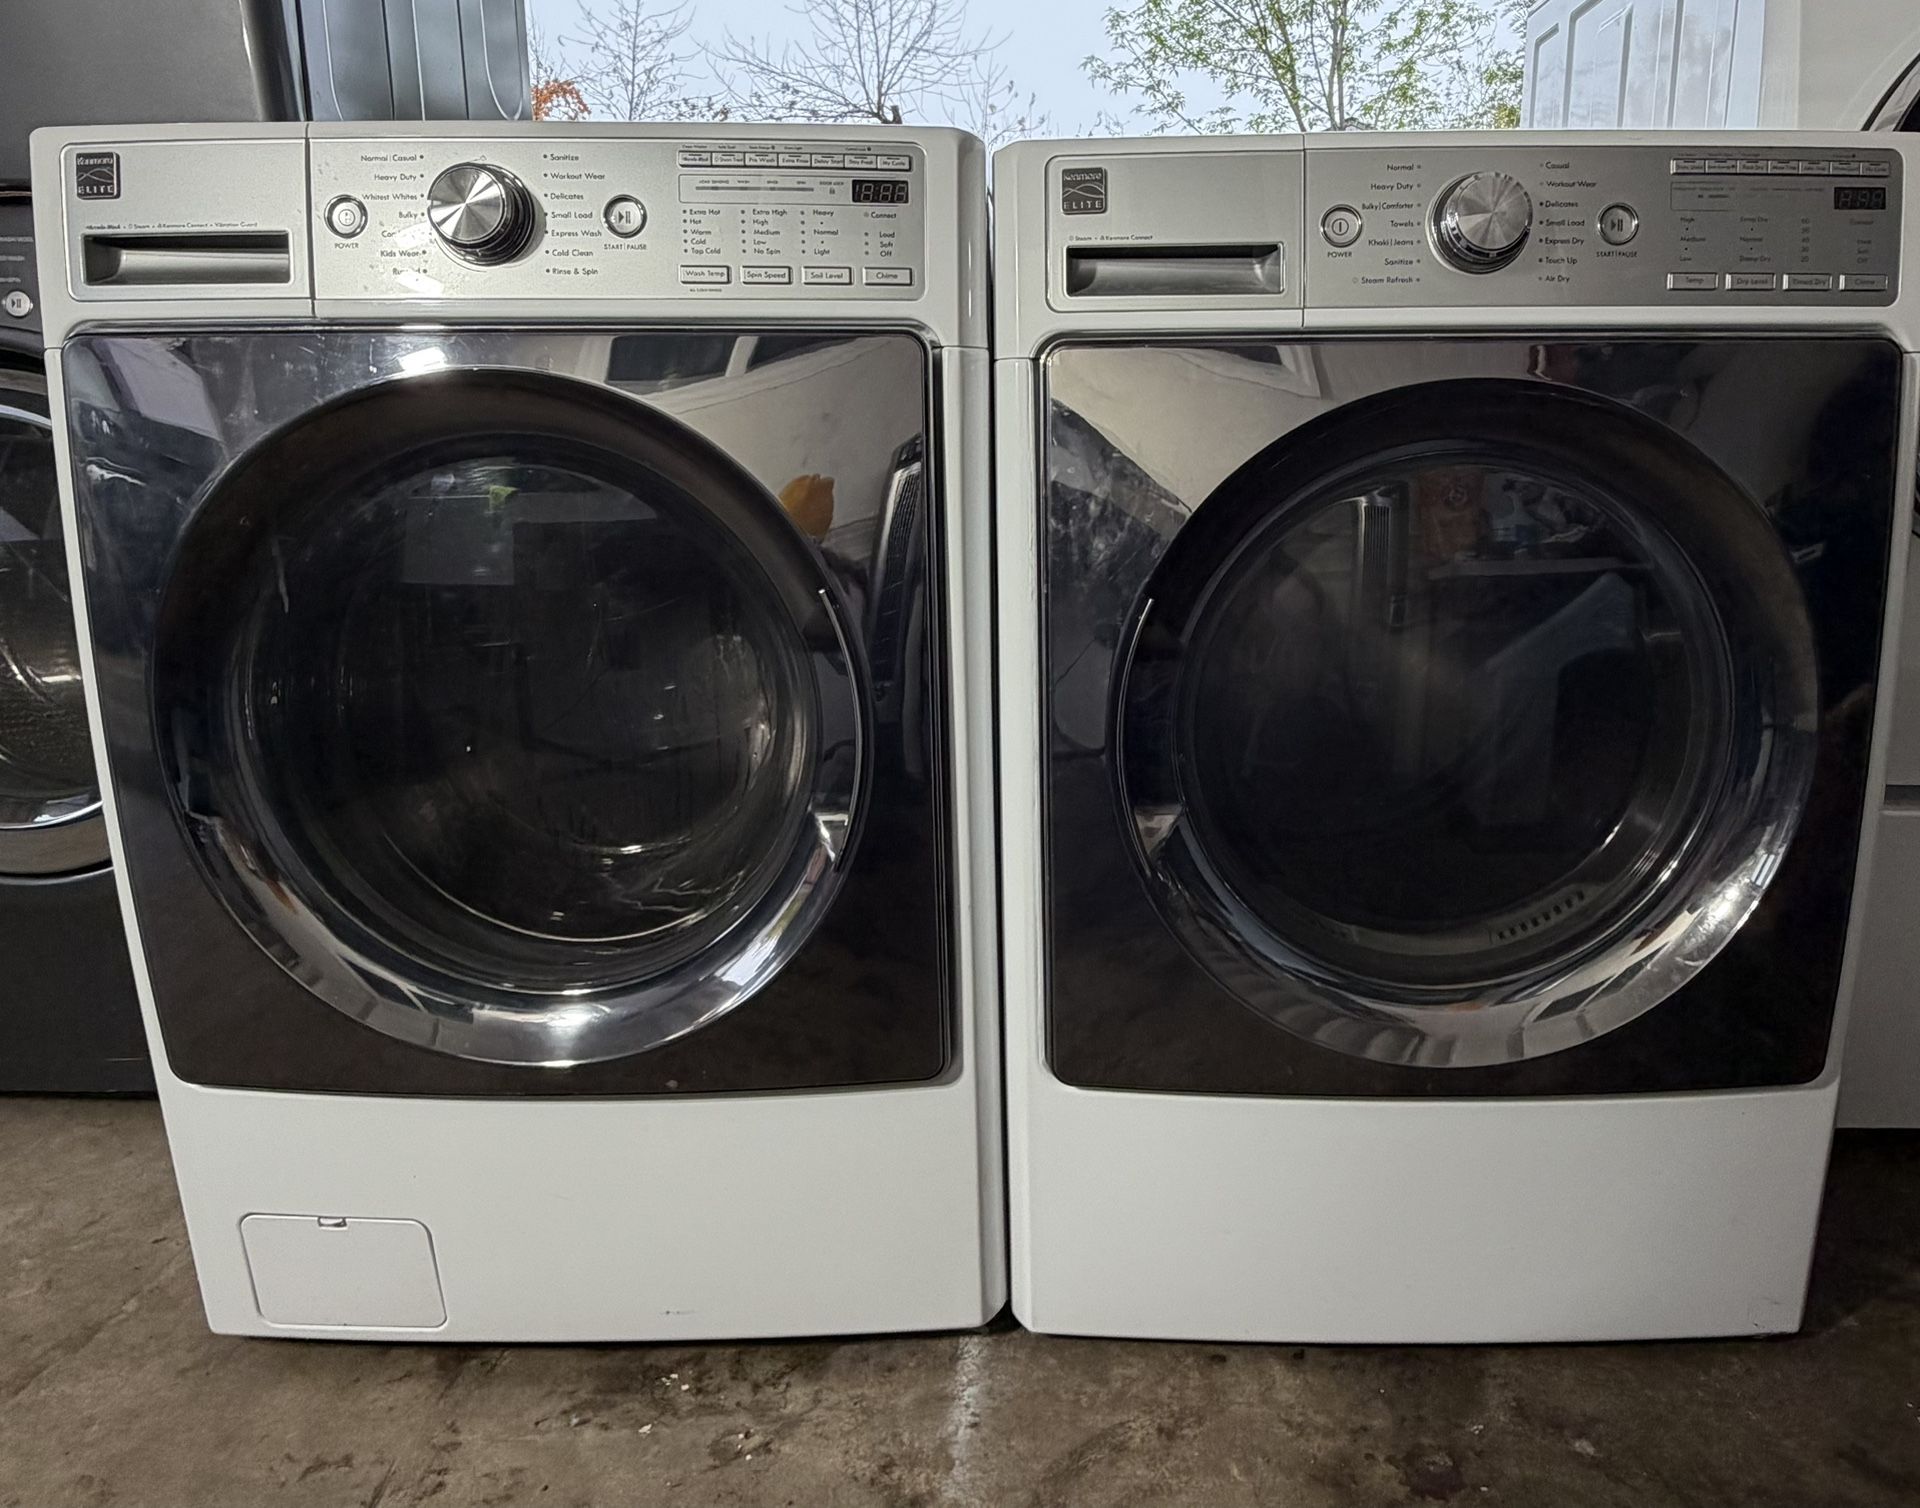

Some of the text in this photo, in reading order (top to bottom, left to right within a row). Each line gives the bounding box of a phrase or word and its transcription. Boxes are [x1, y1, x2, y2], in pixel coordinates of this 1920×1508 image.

[550, 153, 579, 161] Sanitize
[1386, 163, 1414, 171] Normal
[1545, 161, 1570, 169] Casual
[374, 173, 417, 182] Heavy Duty
[550, 172, 606, 180] Workout Wear
[1063, 172, 1102, 181] Kenmore
[1370, 182, 1413, 191] Heavy Duty
[1546, 180, 1597, 188] Workout Wear
[78, 185, 114, 194] ELITE
[361, 193, 418, 201] Whitest Whites
[550, 192, 584, 200] Delicates
[1063, 200, 1102, 209] ELITE
[1545, 200, 1579, 208] Delicates
[398, 211, 418, 220] Bulky
[551, 211, 593, 219] Small Load
[813, 209, 834, 217] Heavy
[871, 211, 897, 219] Connect
[1390, 220, 1414, 228] Towels
[1545, 218, 1566, 226] Small
[551, 229, 602, 238] Express Wash
[1545, 237, 1585, 246] Express Dry
[380, 249, 396, 257] Kids
[552, 249, 593, 257] Cold Clean
[814, 248, 830, 256] Light
[1384, 258, 1414, 266] Sanitize
[1545, 256, 1578, 265] Touch Up
[552, 267, 598, 276] Rinse & Spin
[707, 270, 725, 278] Temp
[746, 271, 786, 279] Spin Speed
[1386, 276, 1413, 284] Refresh
[1557, 275, 1570, 283] Dry
